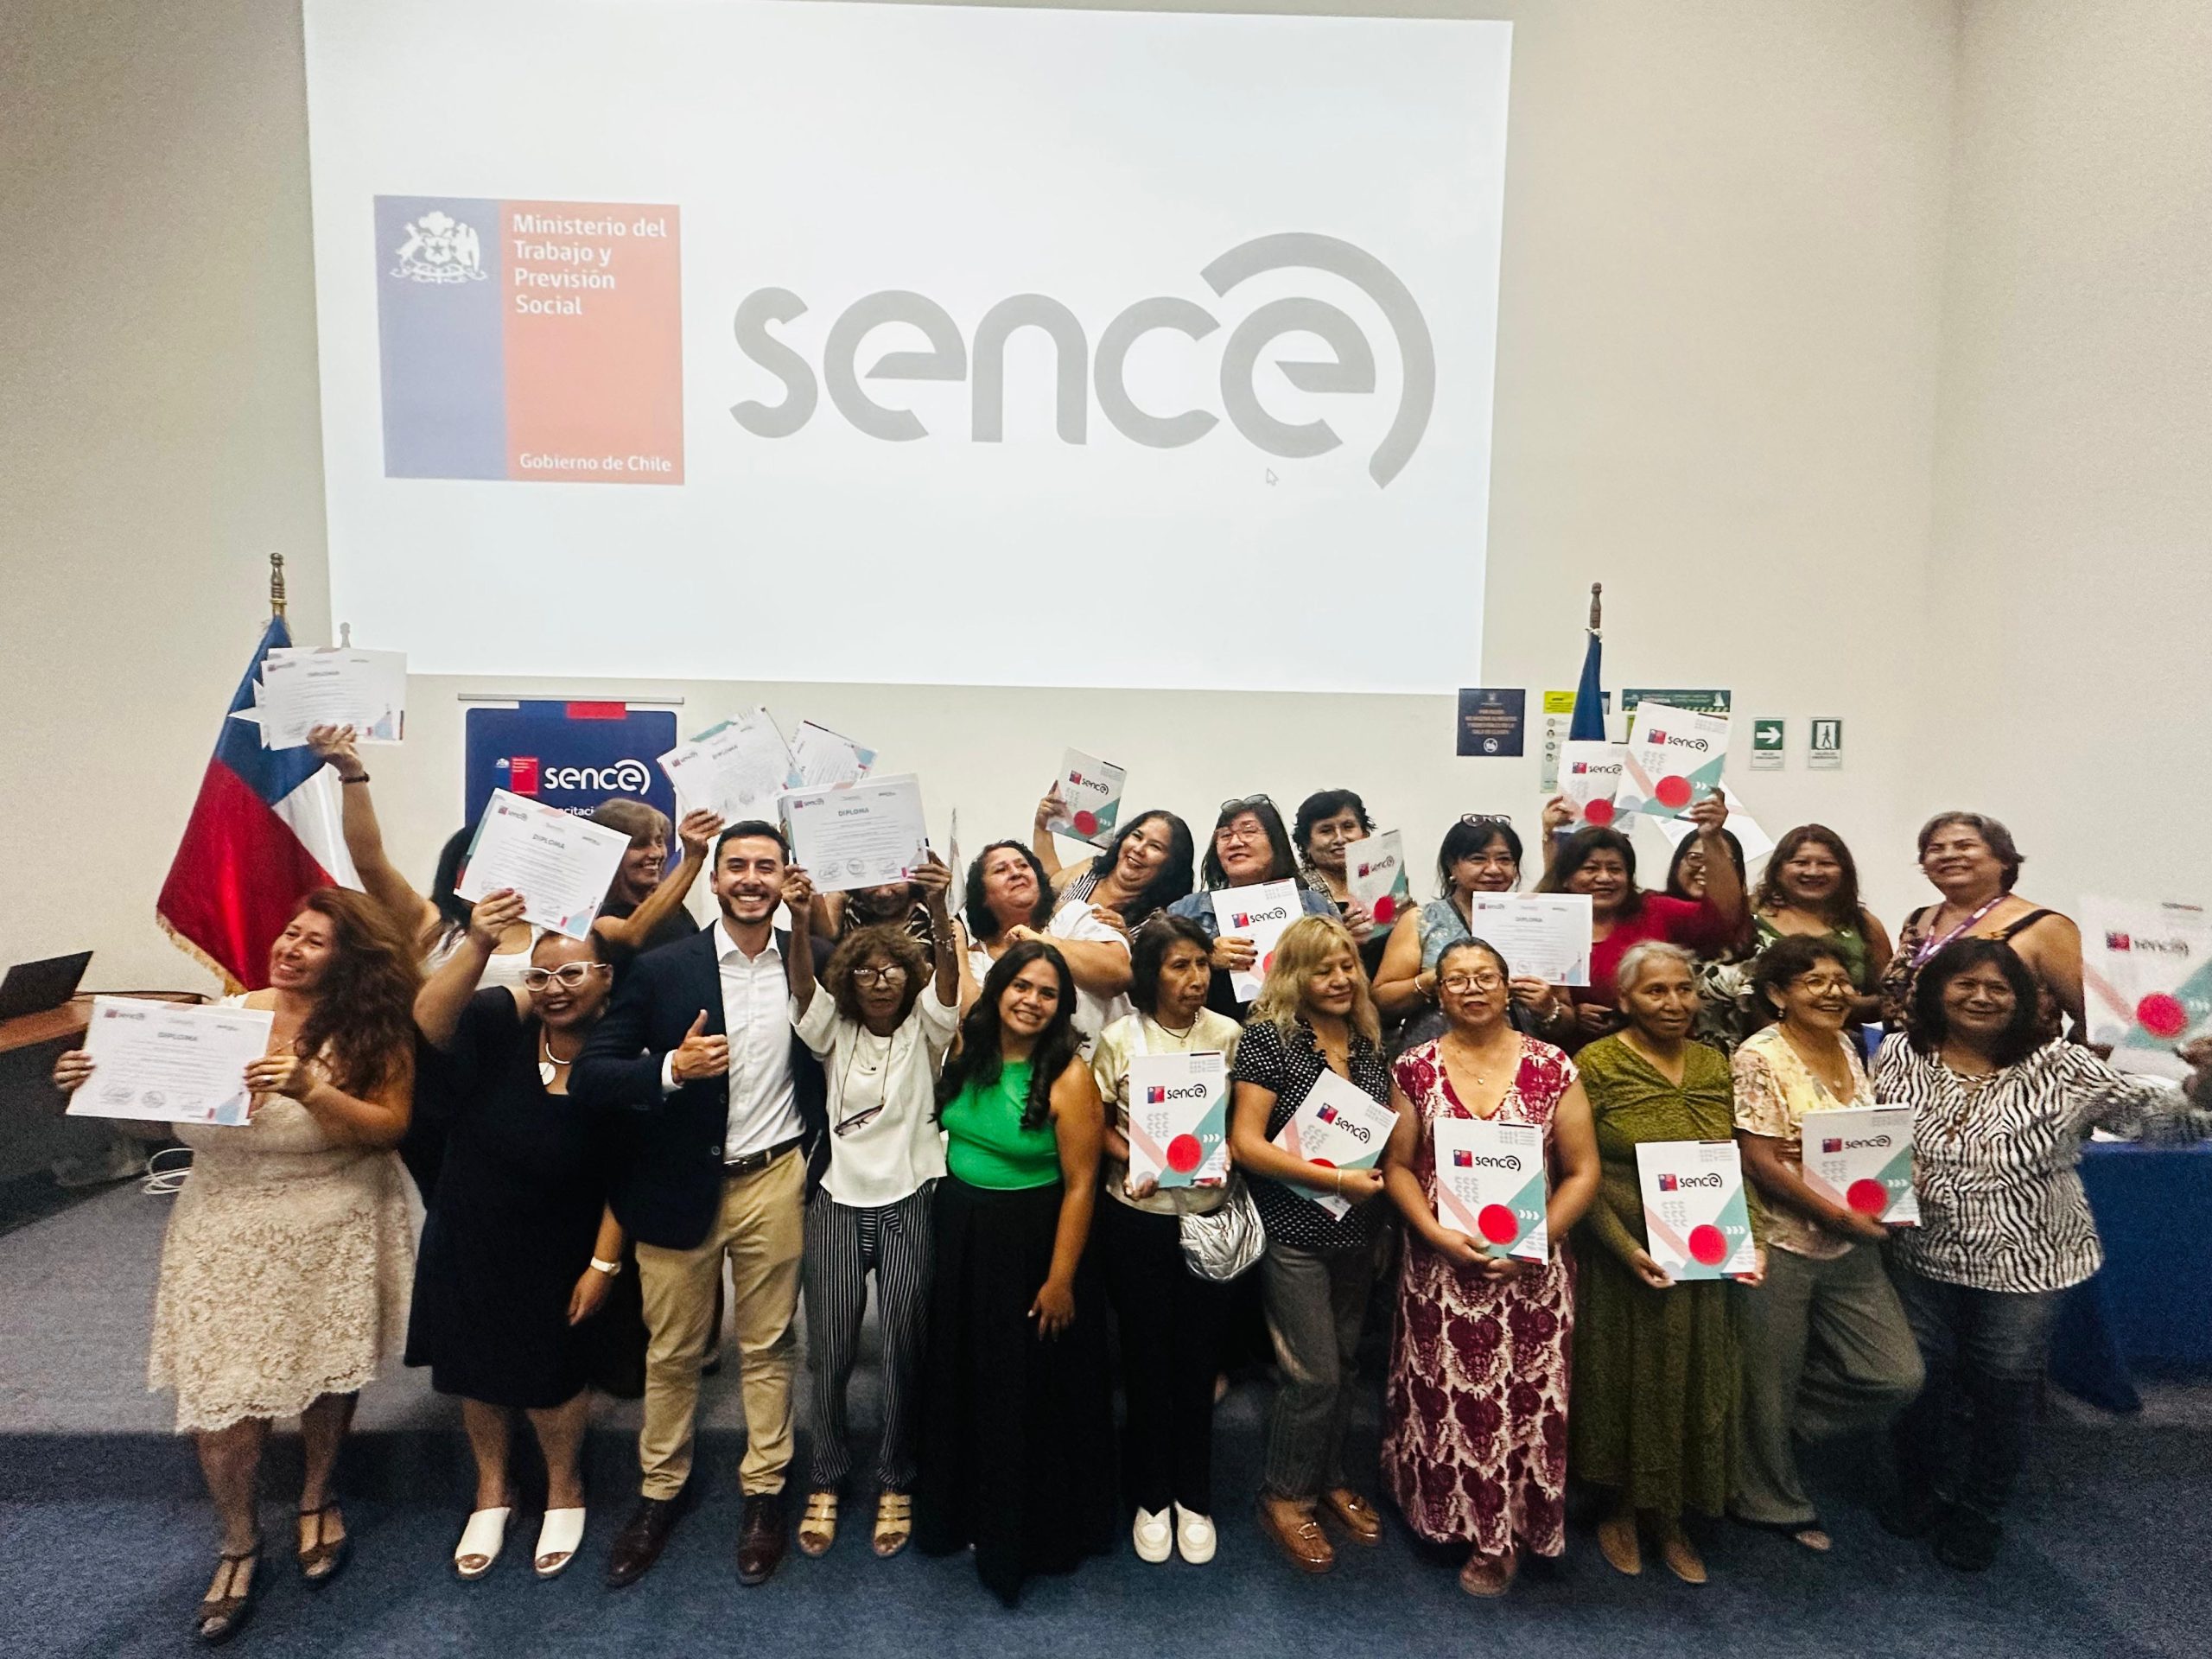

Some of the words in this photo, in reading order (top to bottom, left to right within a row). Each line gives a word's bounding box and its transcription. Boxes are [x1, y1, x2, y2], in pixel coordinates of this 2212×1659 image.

[512, 213, 626, 236] Ministerio
[632, 217, 667, 238] del
[514, 240, 594, 265] Trabajo
[599, 247, 612, 267] y
[514, 268, 615, 289] Previsión
[516, 295, 582, 315] Social
[729, 232, 1436, 490] sence
[519, 453, 599, 471] Gobierno
[602, 455, 623, 471] de
[627, 455, 672, 472] Chile
[1668, 734, 1708, 753] sence
[543, 759, 651, 796] sence
[1081, 778, 1109, 795] sence
[837, 807, 869, 817] DIPLOMA
[532, 833, 566, 849] DIPLOMA
[1249, 906, 1287, 923] sence
[1166, 1084, 1207, 1099] sence
[1335, 1116, 1370, 1144] sence
[1844, 1135, 1892, 1149] sence
[1475, 1155, 1522, 1172] sence
[1679, 1173, 1723, 1188] sence
